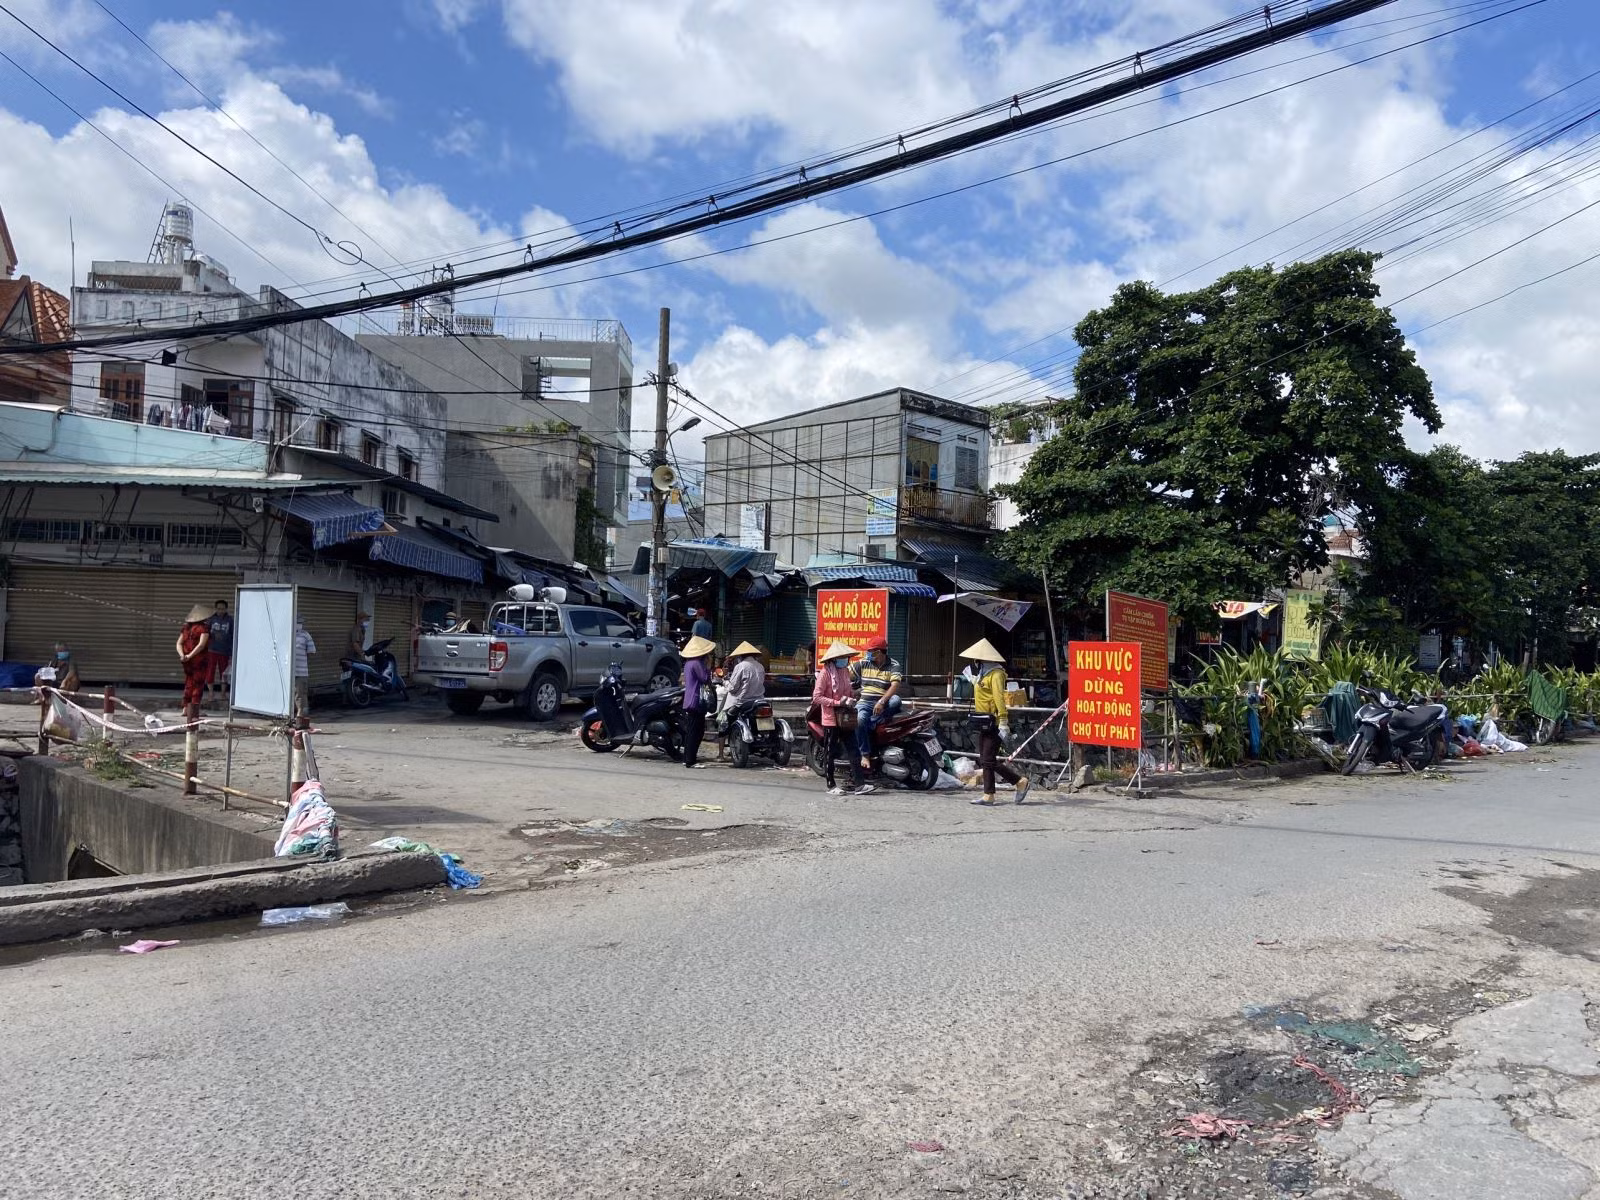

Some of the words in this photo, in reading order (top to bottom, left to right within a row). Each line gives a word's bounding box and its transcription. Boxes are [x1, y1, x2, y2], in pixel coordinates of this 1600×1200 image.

[822, 596, 842, 618] CẤM
[844, 593, 858, 618] ĐỔ
[861, 597, 881, 618] RÁC
[1076, 650, 1102, 670] KHU
[1105, 648, 1133, 675] VỰC
[1084, 677, 1123, 695] DỪNG
[1076, 699, 1102, 716] HOẠT
[1104, 698, 1132, 718] ĐỘNG
[1072, 721, 1092, 739] CHỢ
[1094, 722, 1107, 740] TỰ
[1110, 723, 1136, 740] PHÁT
